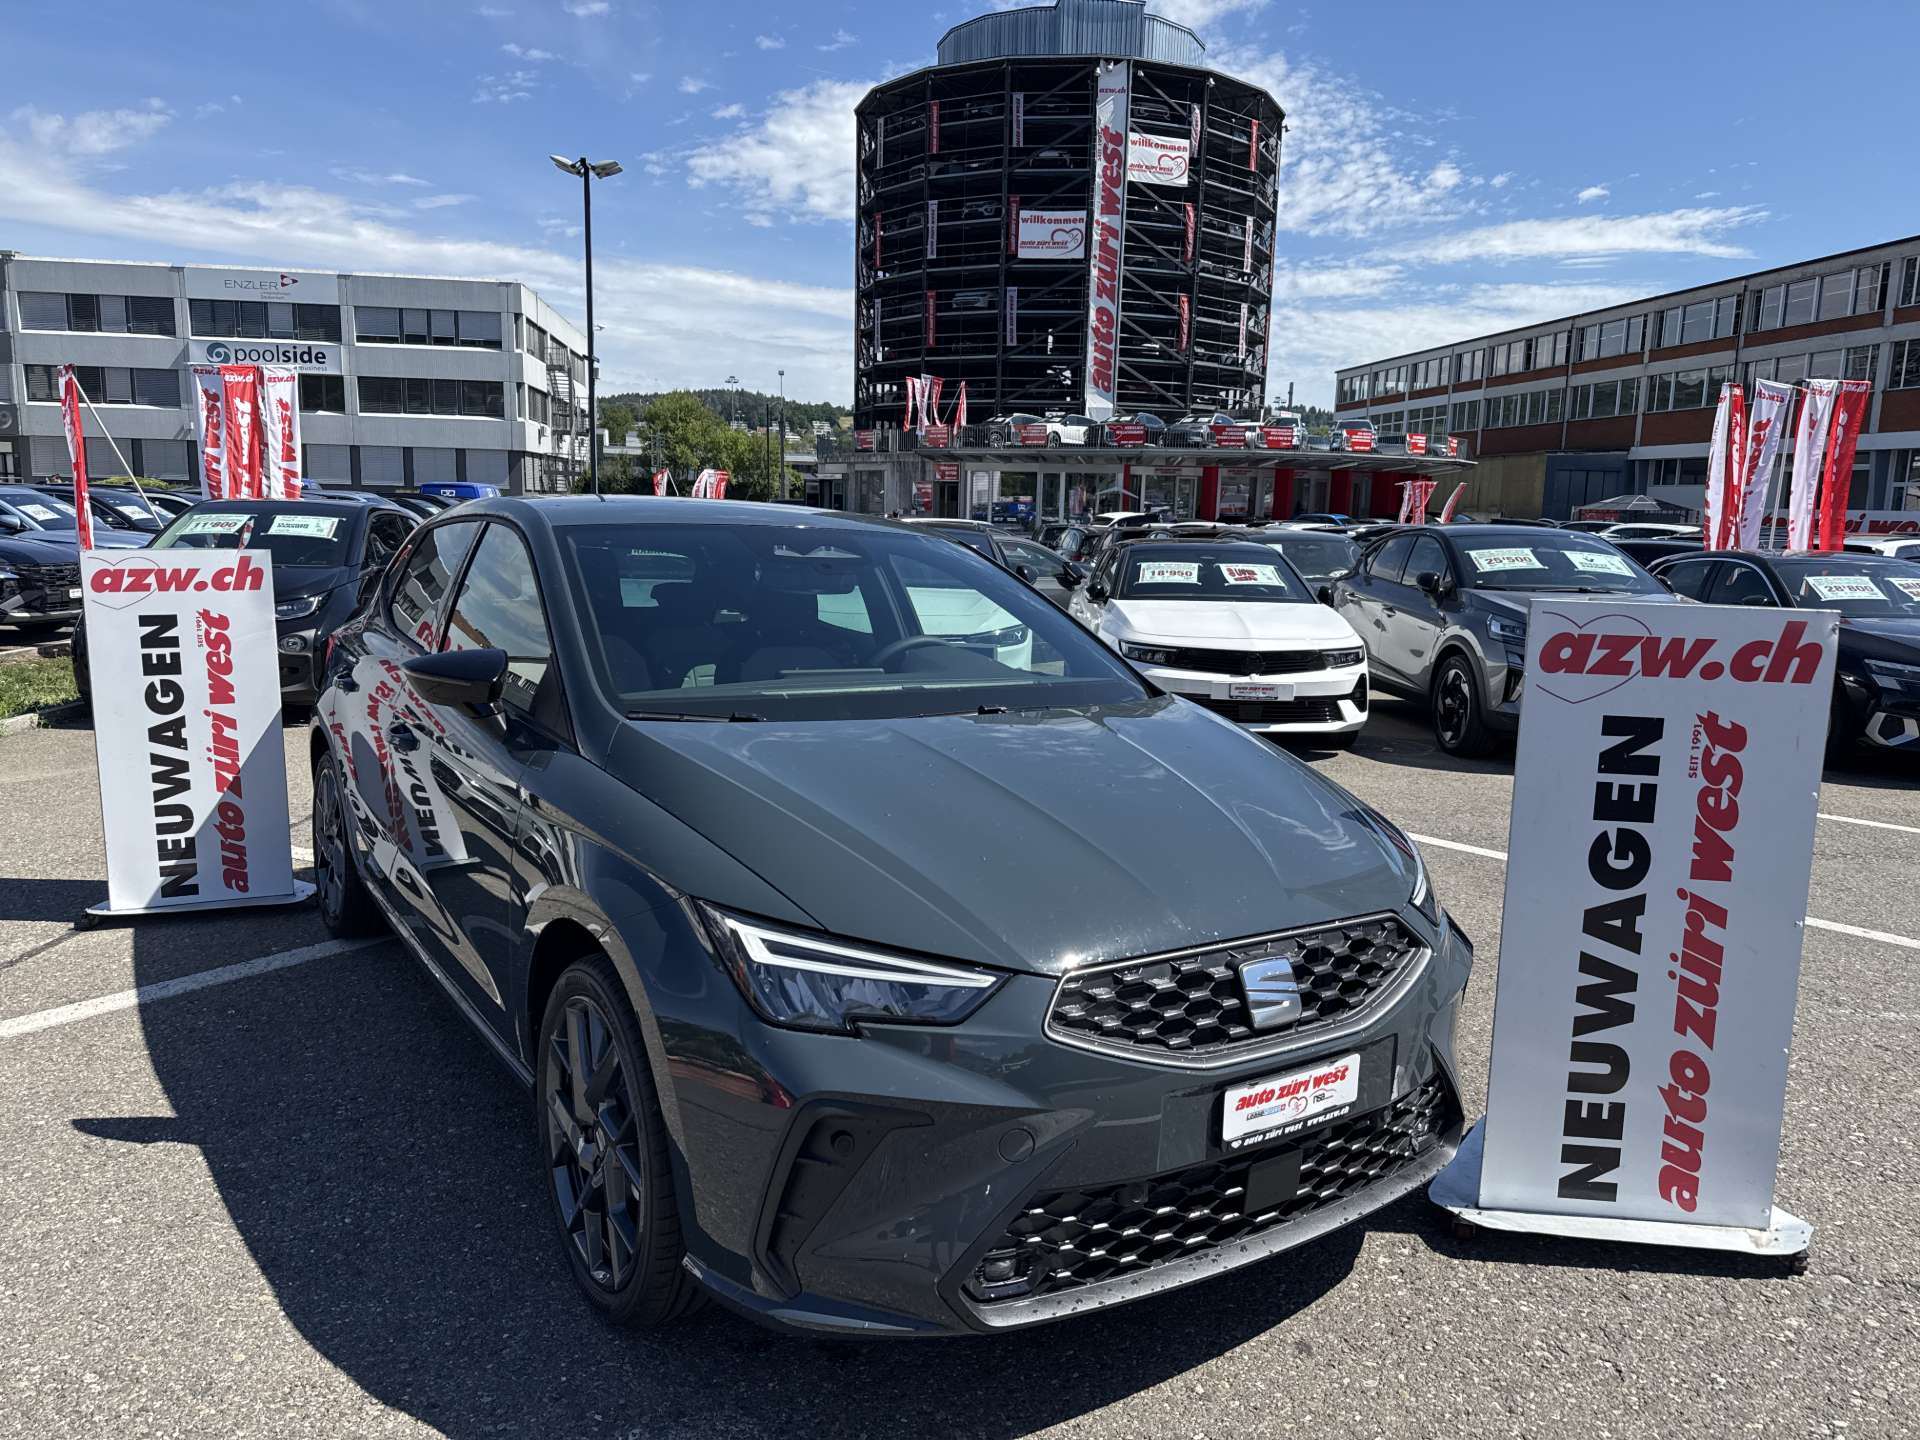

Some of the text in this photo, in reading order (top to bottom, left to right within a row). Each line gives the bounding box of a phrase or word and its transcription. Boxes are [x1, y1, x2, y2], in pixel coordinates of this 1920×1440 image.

[1099, 86, 1127, 94] azw.ch
[1130, 138, 1188, 152] willkommen
[1020, 214, 1085, 225] willkommen
[1092, 124, 1124, 394] auto züri west
[224, 279, 278, 291] ENZLER
[234, 345, 327, 364] poolside
[193, 521, 237, 529] 11'800
[90, 556, 264, 593] azw.ch
[1538, 620, 1823, 685] azw.ch
[138, 613, 201, 899] NEUWAGEN
[198, 608, 250, 894] auto züri west
[1687, 722, 1702, 779] SEIT 1991
[1557, 714, 1665, 1203] NEUWAGEN
[1655, 710, 1748, 1214] auto züri west
[1235, 1088, 1276, 1112] auto
[1276, 1075, 1313, 1100] züri
[1312, 1065, 1349, 1089] west
[1243, 1106, 1350, 1146] auto züri west www.azw.ch
